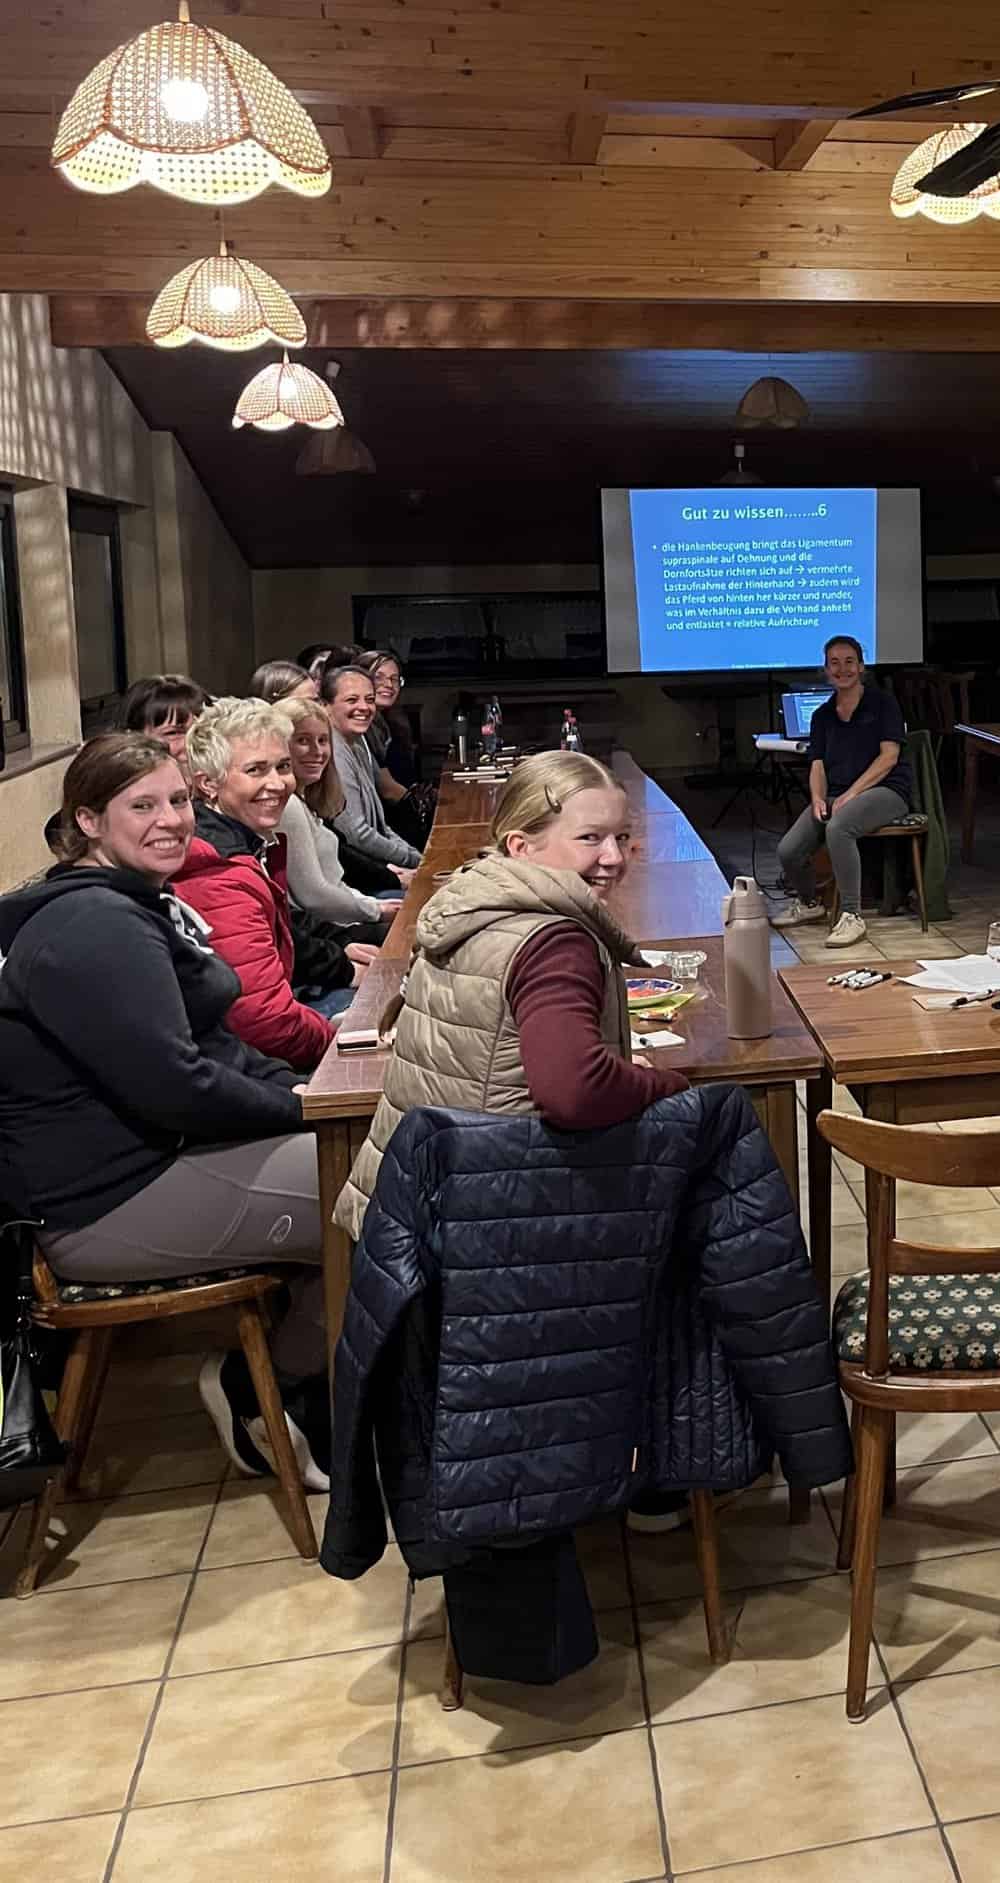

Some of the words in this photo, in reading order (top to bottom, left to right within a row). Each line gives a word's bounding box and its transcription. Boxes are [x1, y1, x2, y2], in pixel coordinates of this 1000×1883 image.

[682, 507, 707, 520] Gut
[712, 508, 729, 519] zu
[662, 542, 676, 552] die
[752, 540, 778, 551] bringt
[781, 539, 796, 549] das
[798, 538, 853, 550] Ligamentum
[663, 555, 718, 566] supraspinale
[720, 554, 735, 564] auf
[737, 552, 777, 564] Dehnung
[779, 552, 796, 561] und
[799, 552, 813, 561] die
[726, 567, 757, 577] richten
[760, 566, 776, 576] sich
[779, 566, 793, 575] auf
[807, 564, 853, 574] vermehrte
[664, 581, 726, 592] Lastaufnahme
[728, 580, 743, 590] der
[745, 579, 794, 590] Hinterhand
[809, 577, 839, 587] zudem
[841, 576, 860, 586] wird
[665, 595, 680, 605] das
[682, 594, 705, 604] Pferd
[707, 595, 724, 603] von
[726, 593, 754, 602] hinten
[757, 593, 771, 602] her
[773, 591, 800, 601] kürzer
[803, 591, 820, 600] und
[666, 609, 683, 617] was
[685, 608, 696, 616] im
[697, 607, 741, 616] Verhältnis
[744, 606, 764, 615] dazu
[767, 604, 780, 614] die
[782, 603, 819, 613] Vorhand
[822, 603, 851, 612] anhebt
[666, 621, 683, 630] und
[685, 620, 724, 629] entlastet
[734, 618, 766, 628] relative
[768, 616, 819, 627] Aufrichtung
